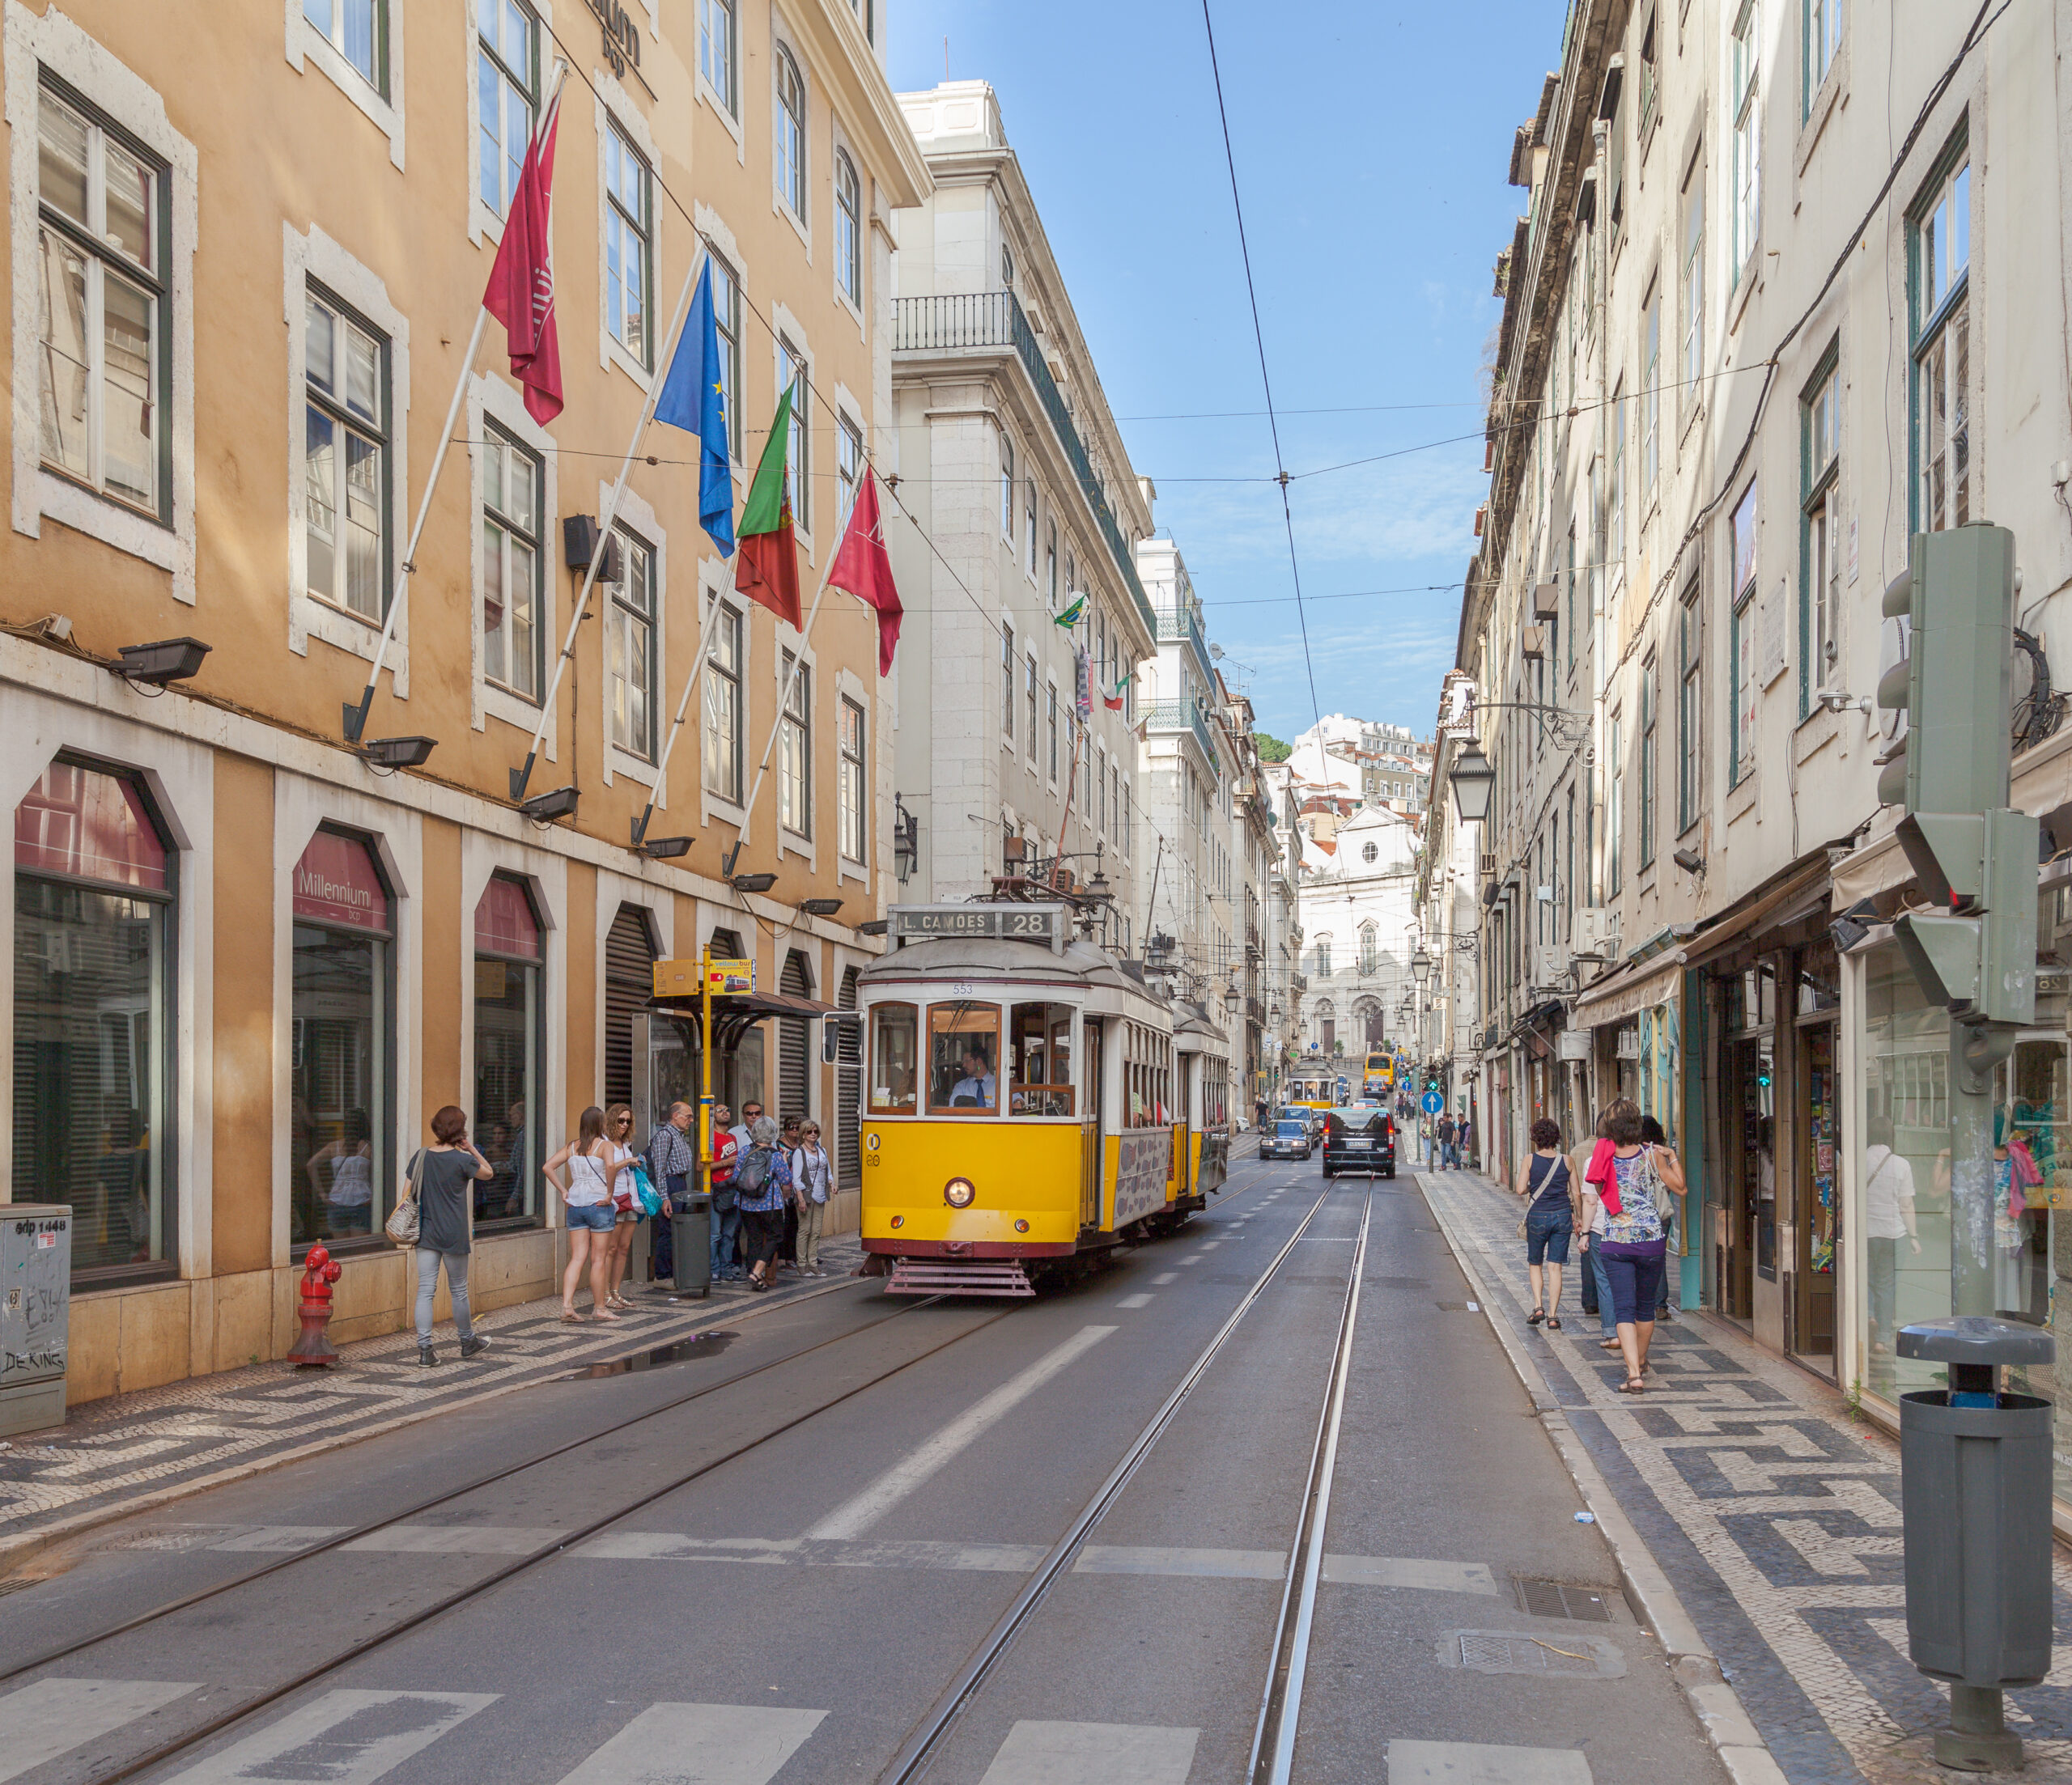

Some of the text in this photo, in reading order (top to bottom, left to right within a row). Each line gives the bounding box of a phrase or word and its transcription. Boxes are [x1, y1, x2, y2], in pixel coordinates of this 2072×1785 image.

[603, 27, 625, 81] bcp
[299, 863, 369, 907] Millennium
[349, 906, 361, 923] bcp
[905, 914, 985, 929] L. CAMÕES
[1013, 914, 1043, 933] 28
[953, 984, 973, 994] 553
